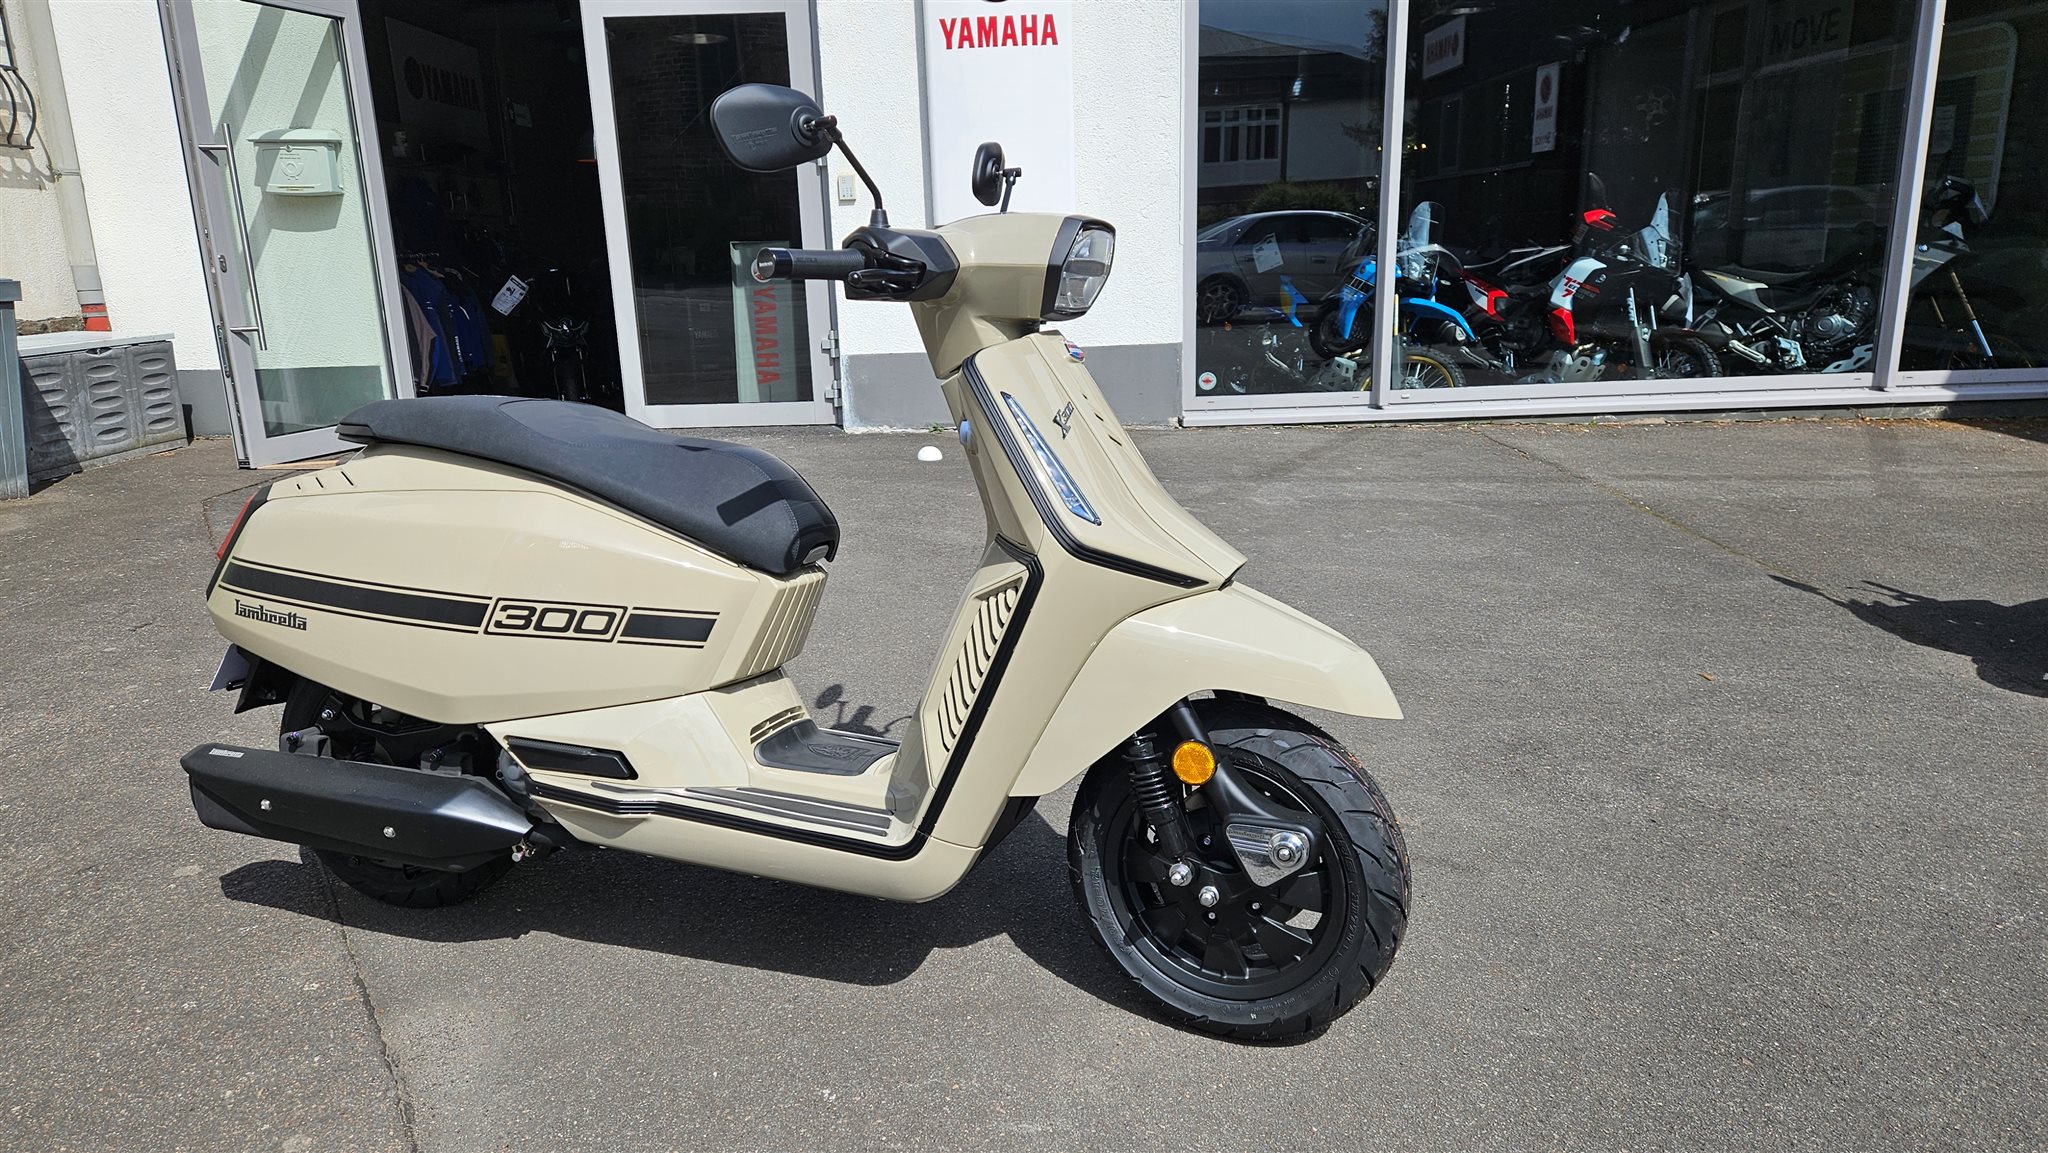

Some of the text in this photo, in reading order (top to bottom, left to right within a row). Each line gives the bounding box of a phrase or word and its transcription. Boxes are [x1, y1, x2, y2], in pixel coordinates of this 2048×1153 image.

[939, 14, 1058, 50] YAMAHA
[418, 62, 481, 112] YAMAHA
[753, 285, 781, 385] YAMAHA
[494, 604, 617, 635] 300
